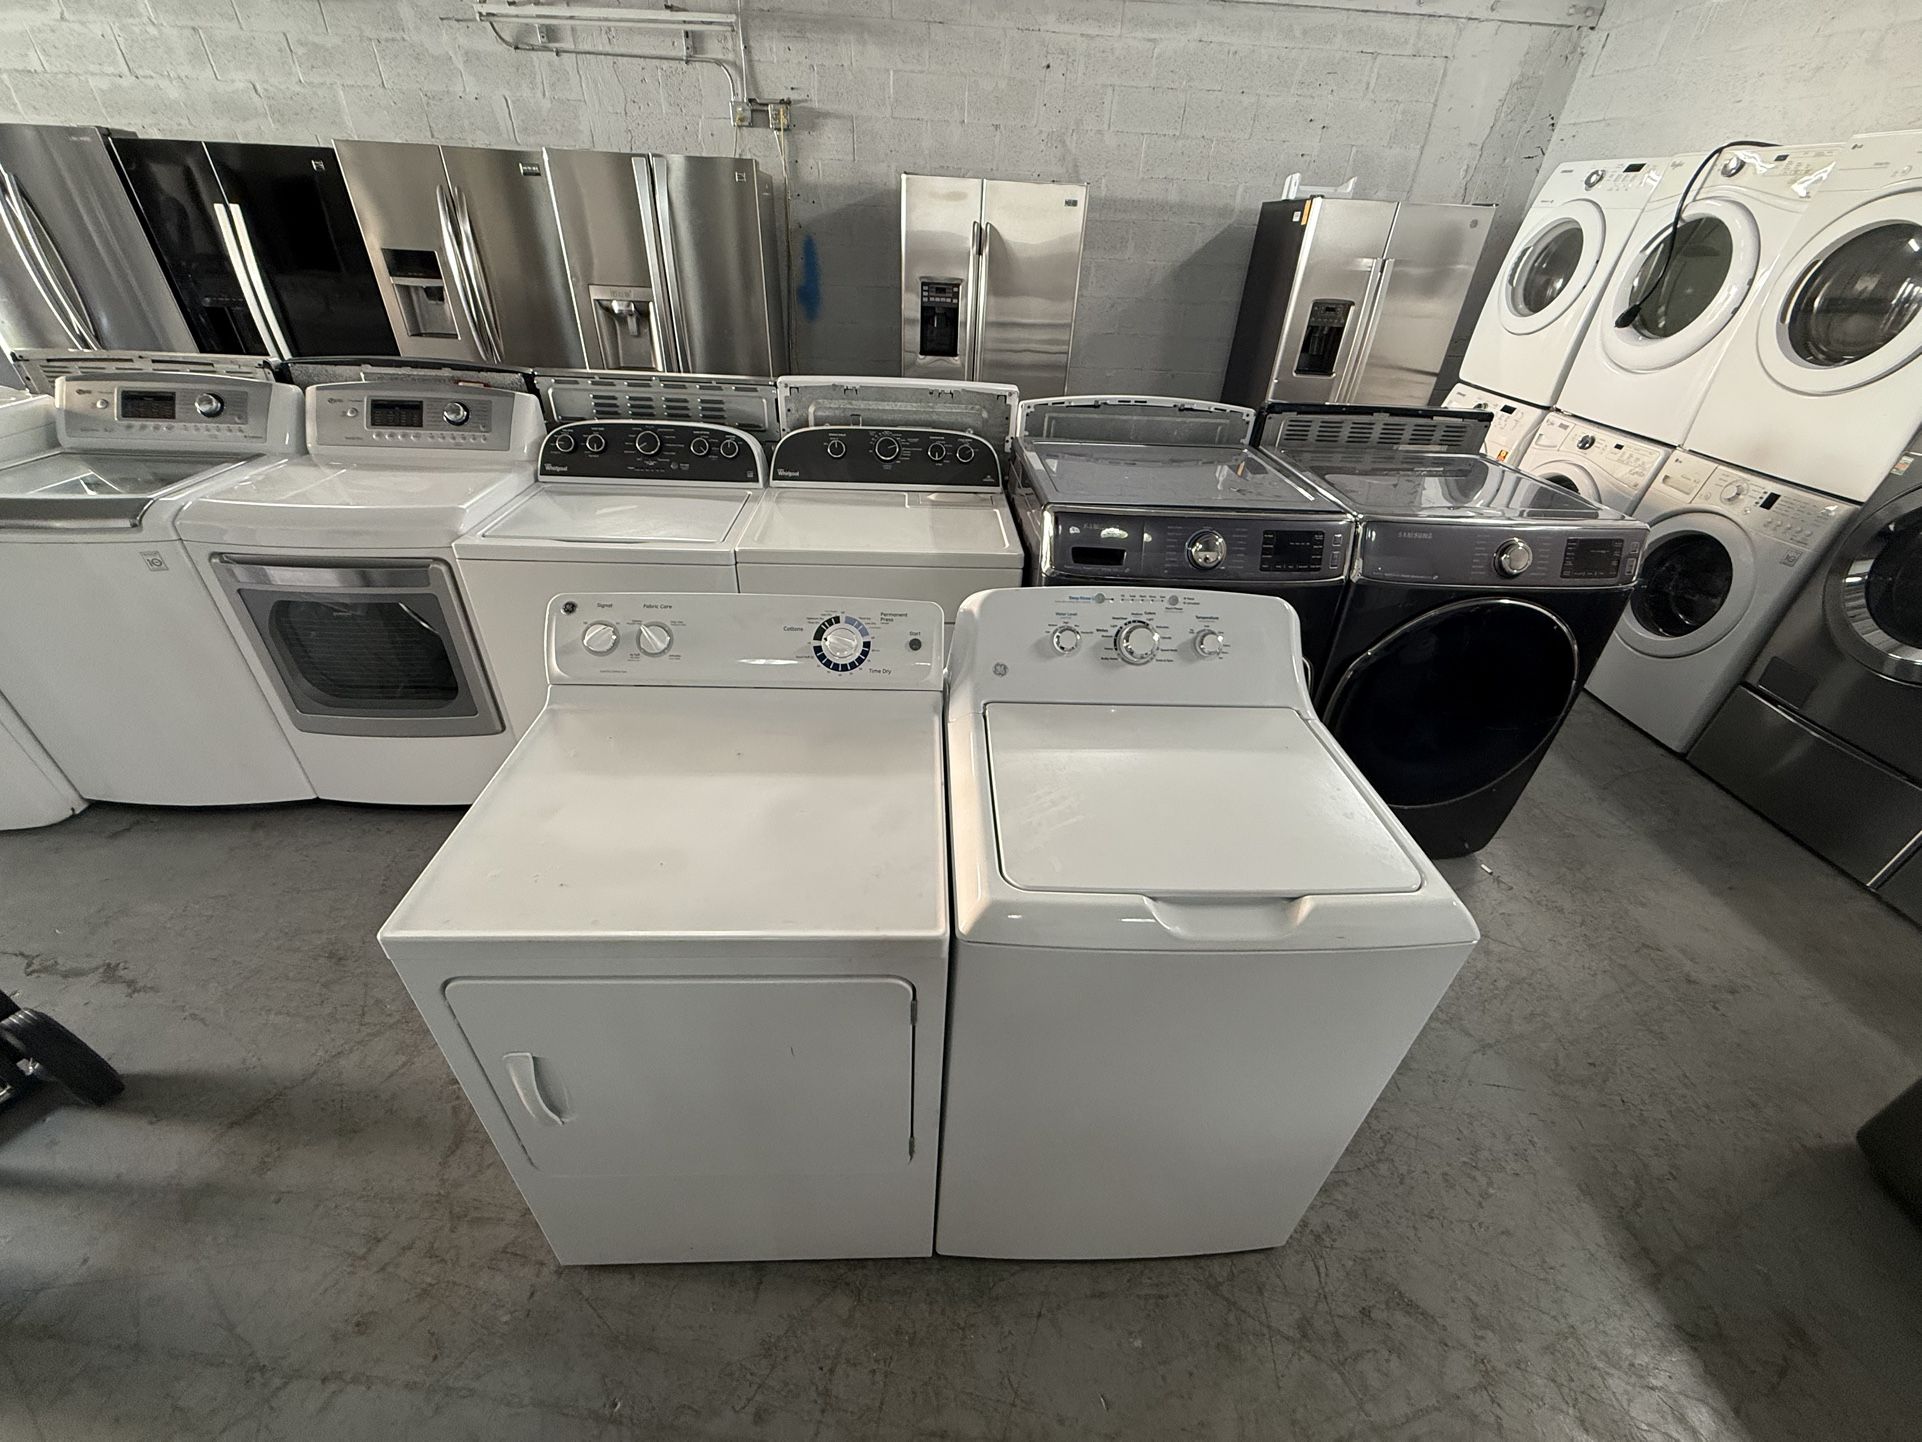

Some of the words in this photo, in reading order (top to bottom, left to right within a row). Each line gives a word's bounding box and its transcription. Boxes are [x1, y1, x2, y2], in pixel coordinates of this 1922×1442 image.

[544, 463, 568, 472] Whirlpool
[777, 468, 800, 477] Whirlpool
[1398, 531, 1433, 539] SAMSUNG
